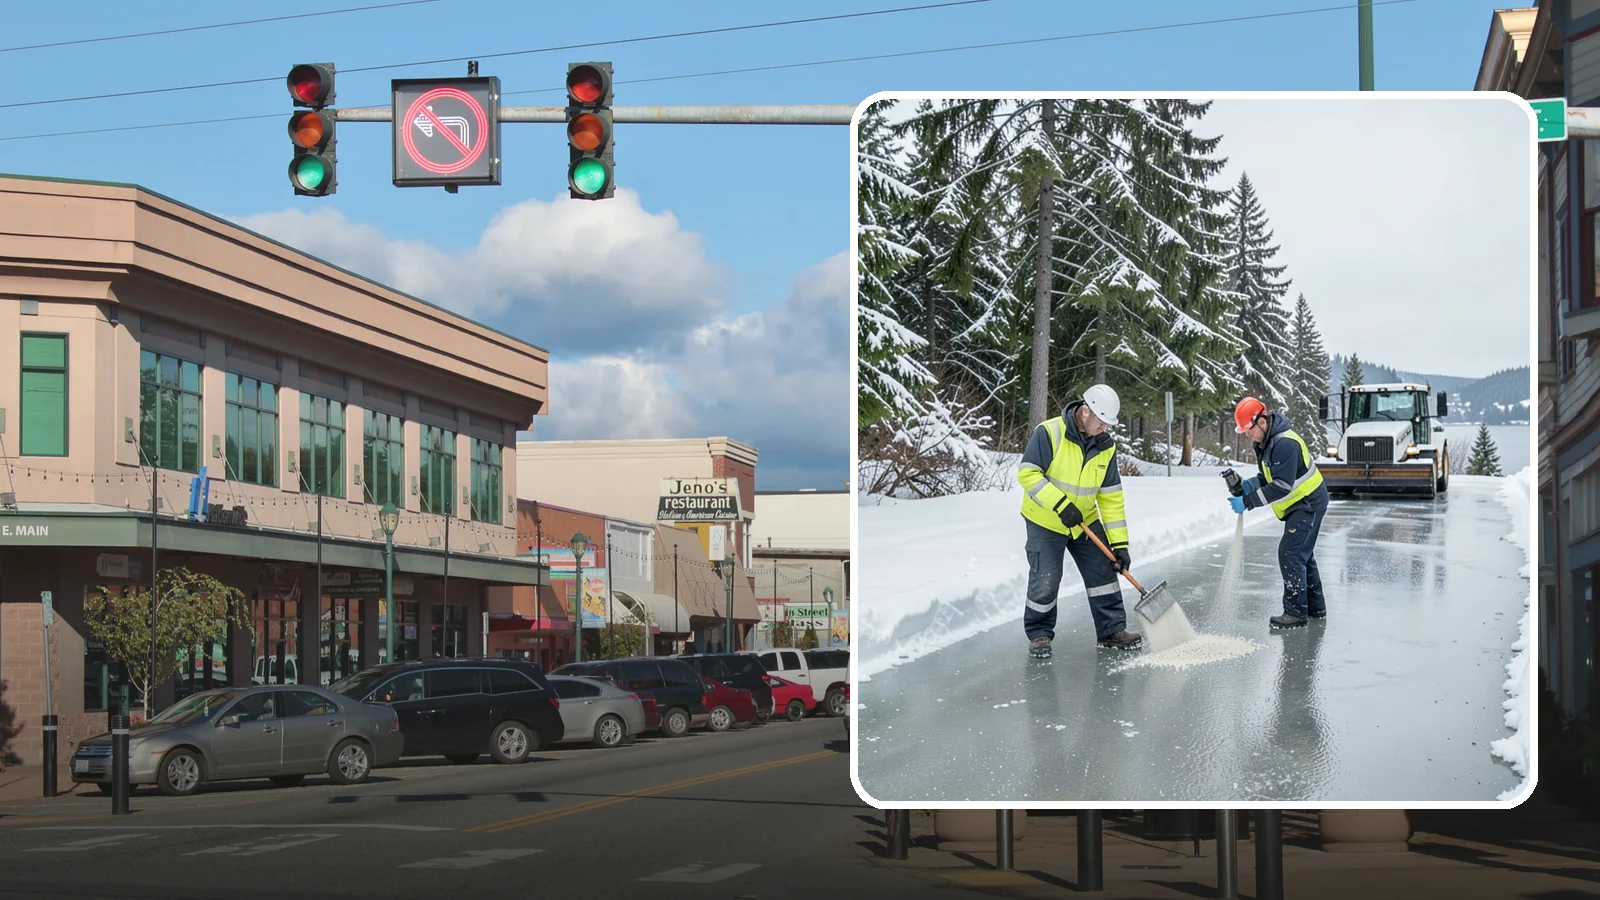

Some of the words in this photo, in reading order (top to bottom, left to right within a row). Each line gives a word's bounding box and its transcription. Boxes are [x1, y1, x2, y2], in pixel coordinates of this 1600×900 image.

[670, 480, 727, 494] Jeno's
[665, 497, 731, 509] restaurant
[659, 510, 681, 519] Italian
[686, 510, 714, 519] American
[715, 510, 737, 519] Cuisine
[2, 525, 13, 536] E.
[15, 525, 49, 536] MAIN
[797, 608, 828, 617] Street
